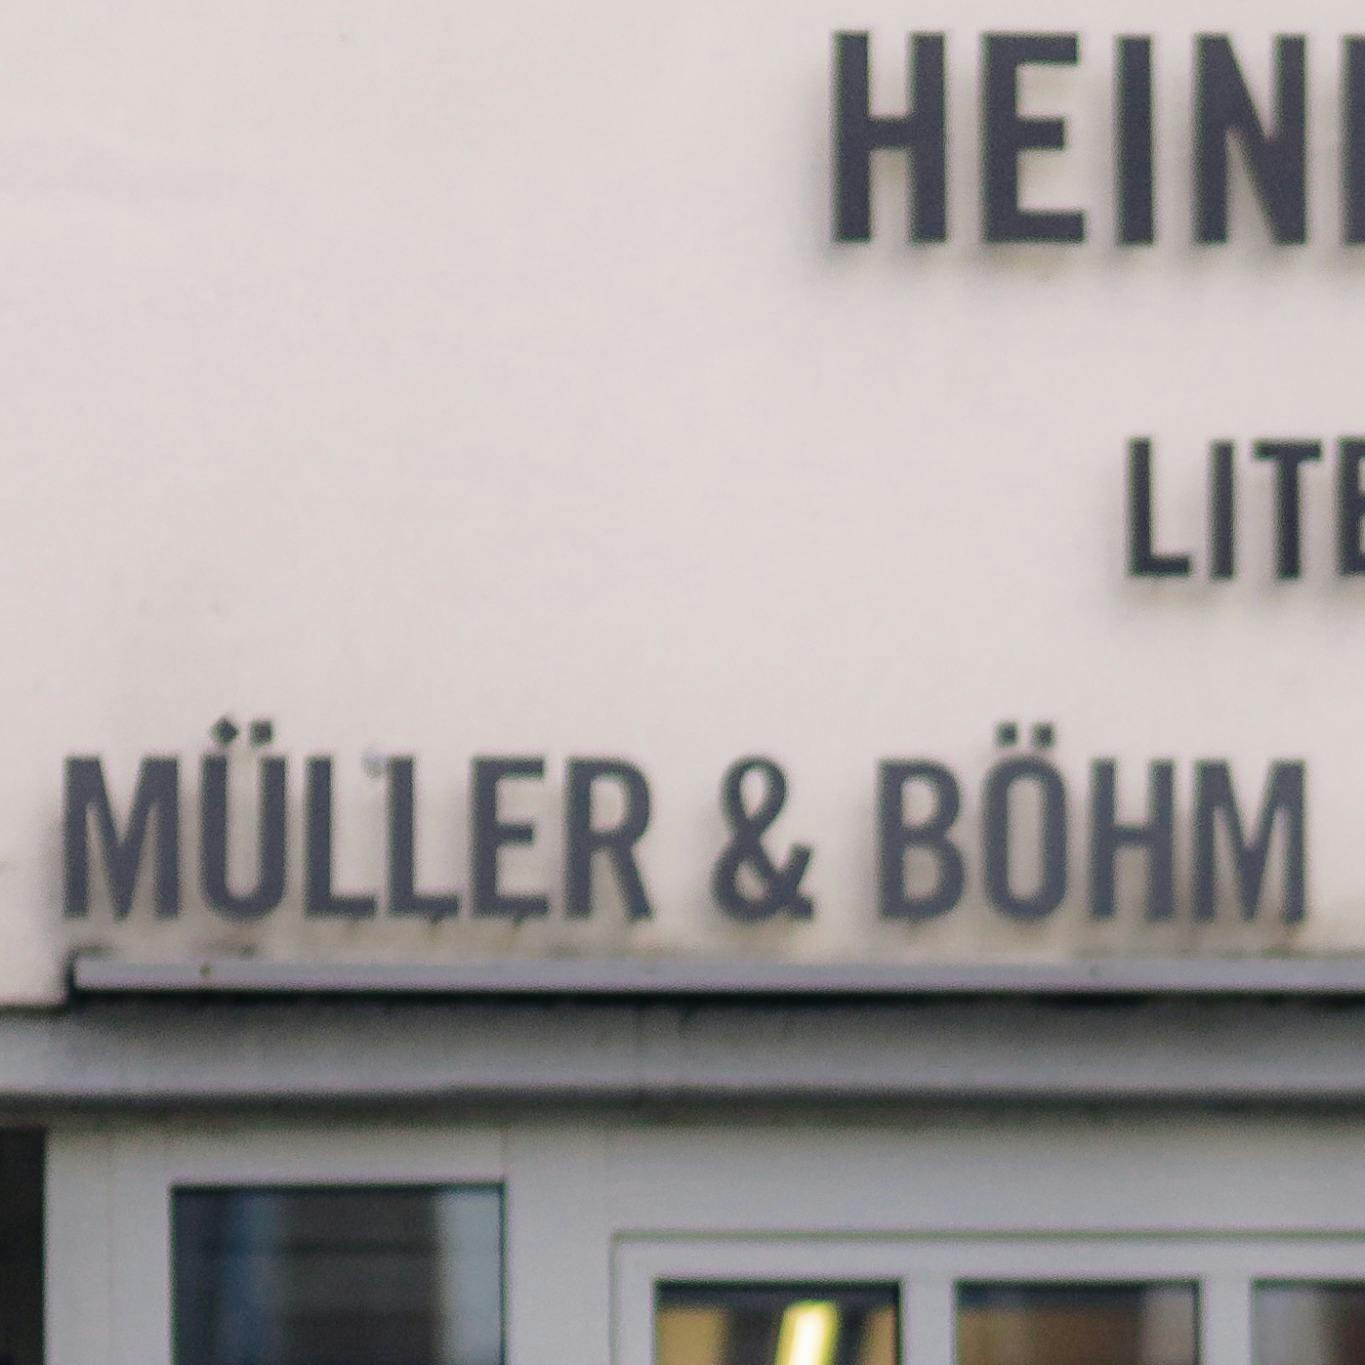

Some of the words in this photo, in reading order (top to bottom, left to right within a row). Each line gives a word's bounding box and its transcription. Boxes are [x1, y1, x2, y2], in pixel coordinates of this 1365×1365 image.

[60, 716, 656, 922] MÜLLER
[709, 756, 816, 921] &
[872, 722, 1309, 926] BÖHM
